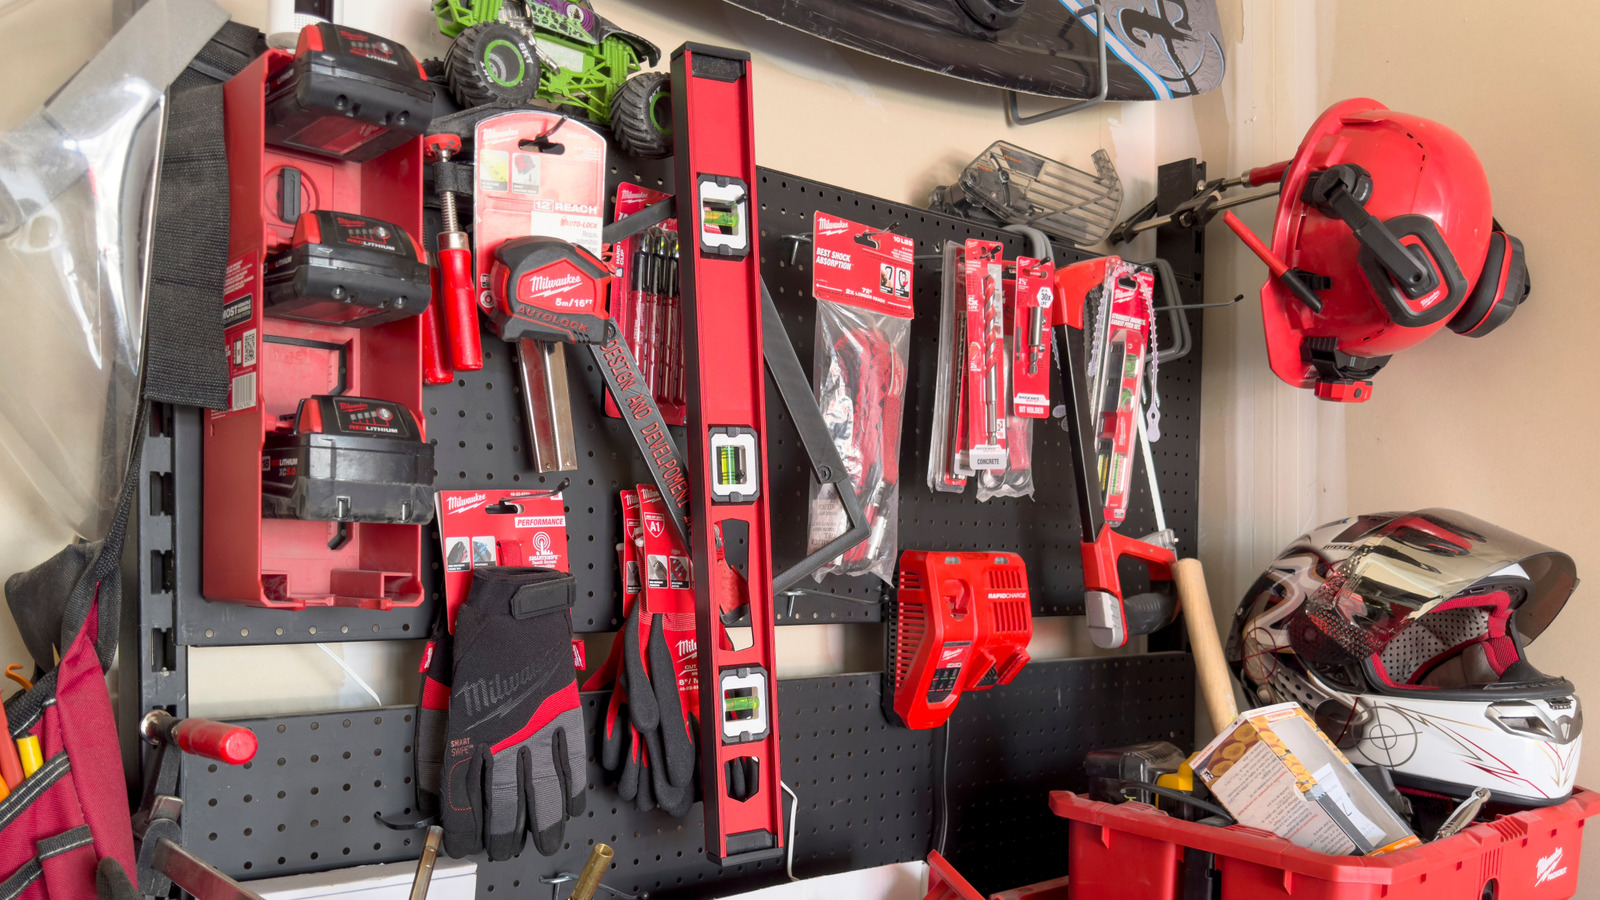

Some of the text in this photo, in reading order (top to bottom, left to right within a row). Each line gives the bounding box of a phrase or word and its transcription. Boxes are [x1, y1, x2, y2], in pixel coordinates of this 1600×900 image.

[554, 202, 598, 215] REACH
[817, 217, 849, 231] Milwaukee
[816, 247, 851, 263] BEST SHOCK
[529, 273, 582, 293] Milwaukee
[516, 305, 589, 332] AUTOLOCK
[600, 338, 638, 392] DESIGN
[626, 393, 652, 420] AND
[1018, 405, 1045, 415] BIT HOLDER
[349, 424, 399, 434] REDLITHIUM
[446, 493, 487, 511] Milwaukee
[517, 518, 564, 527] PERFORMANCE
[650, 520, 661, 533] A1
[450, 737, 471, 748] SMART
